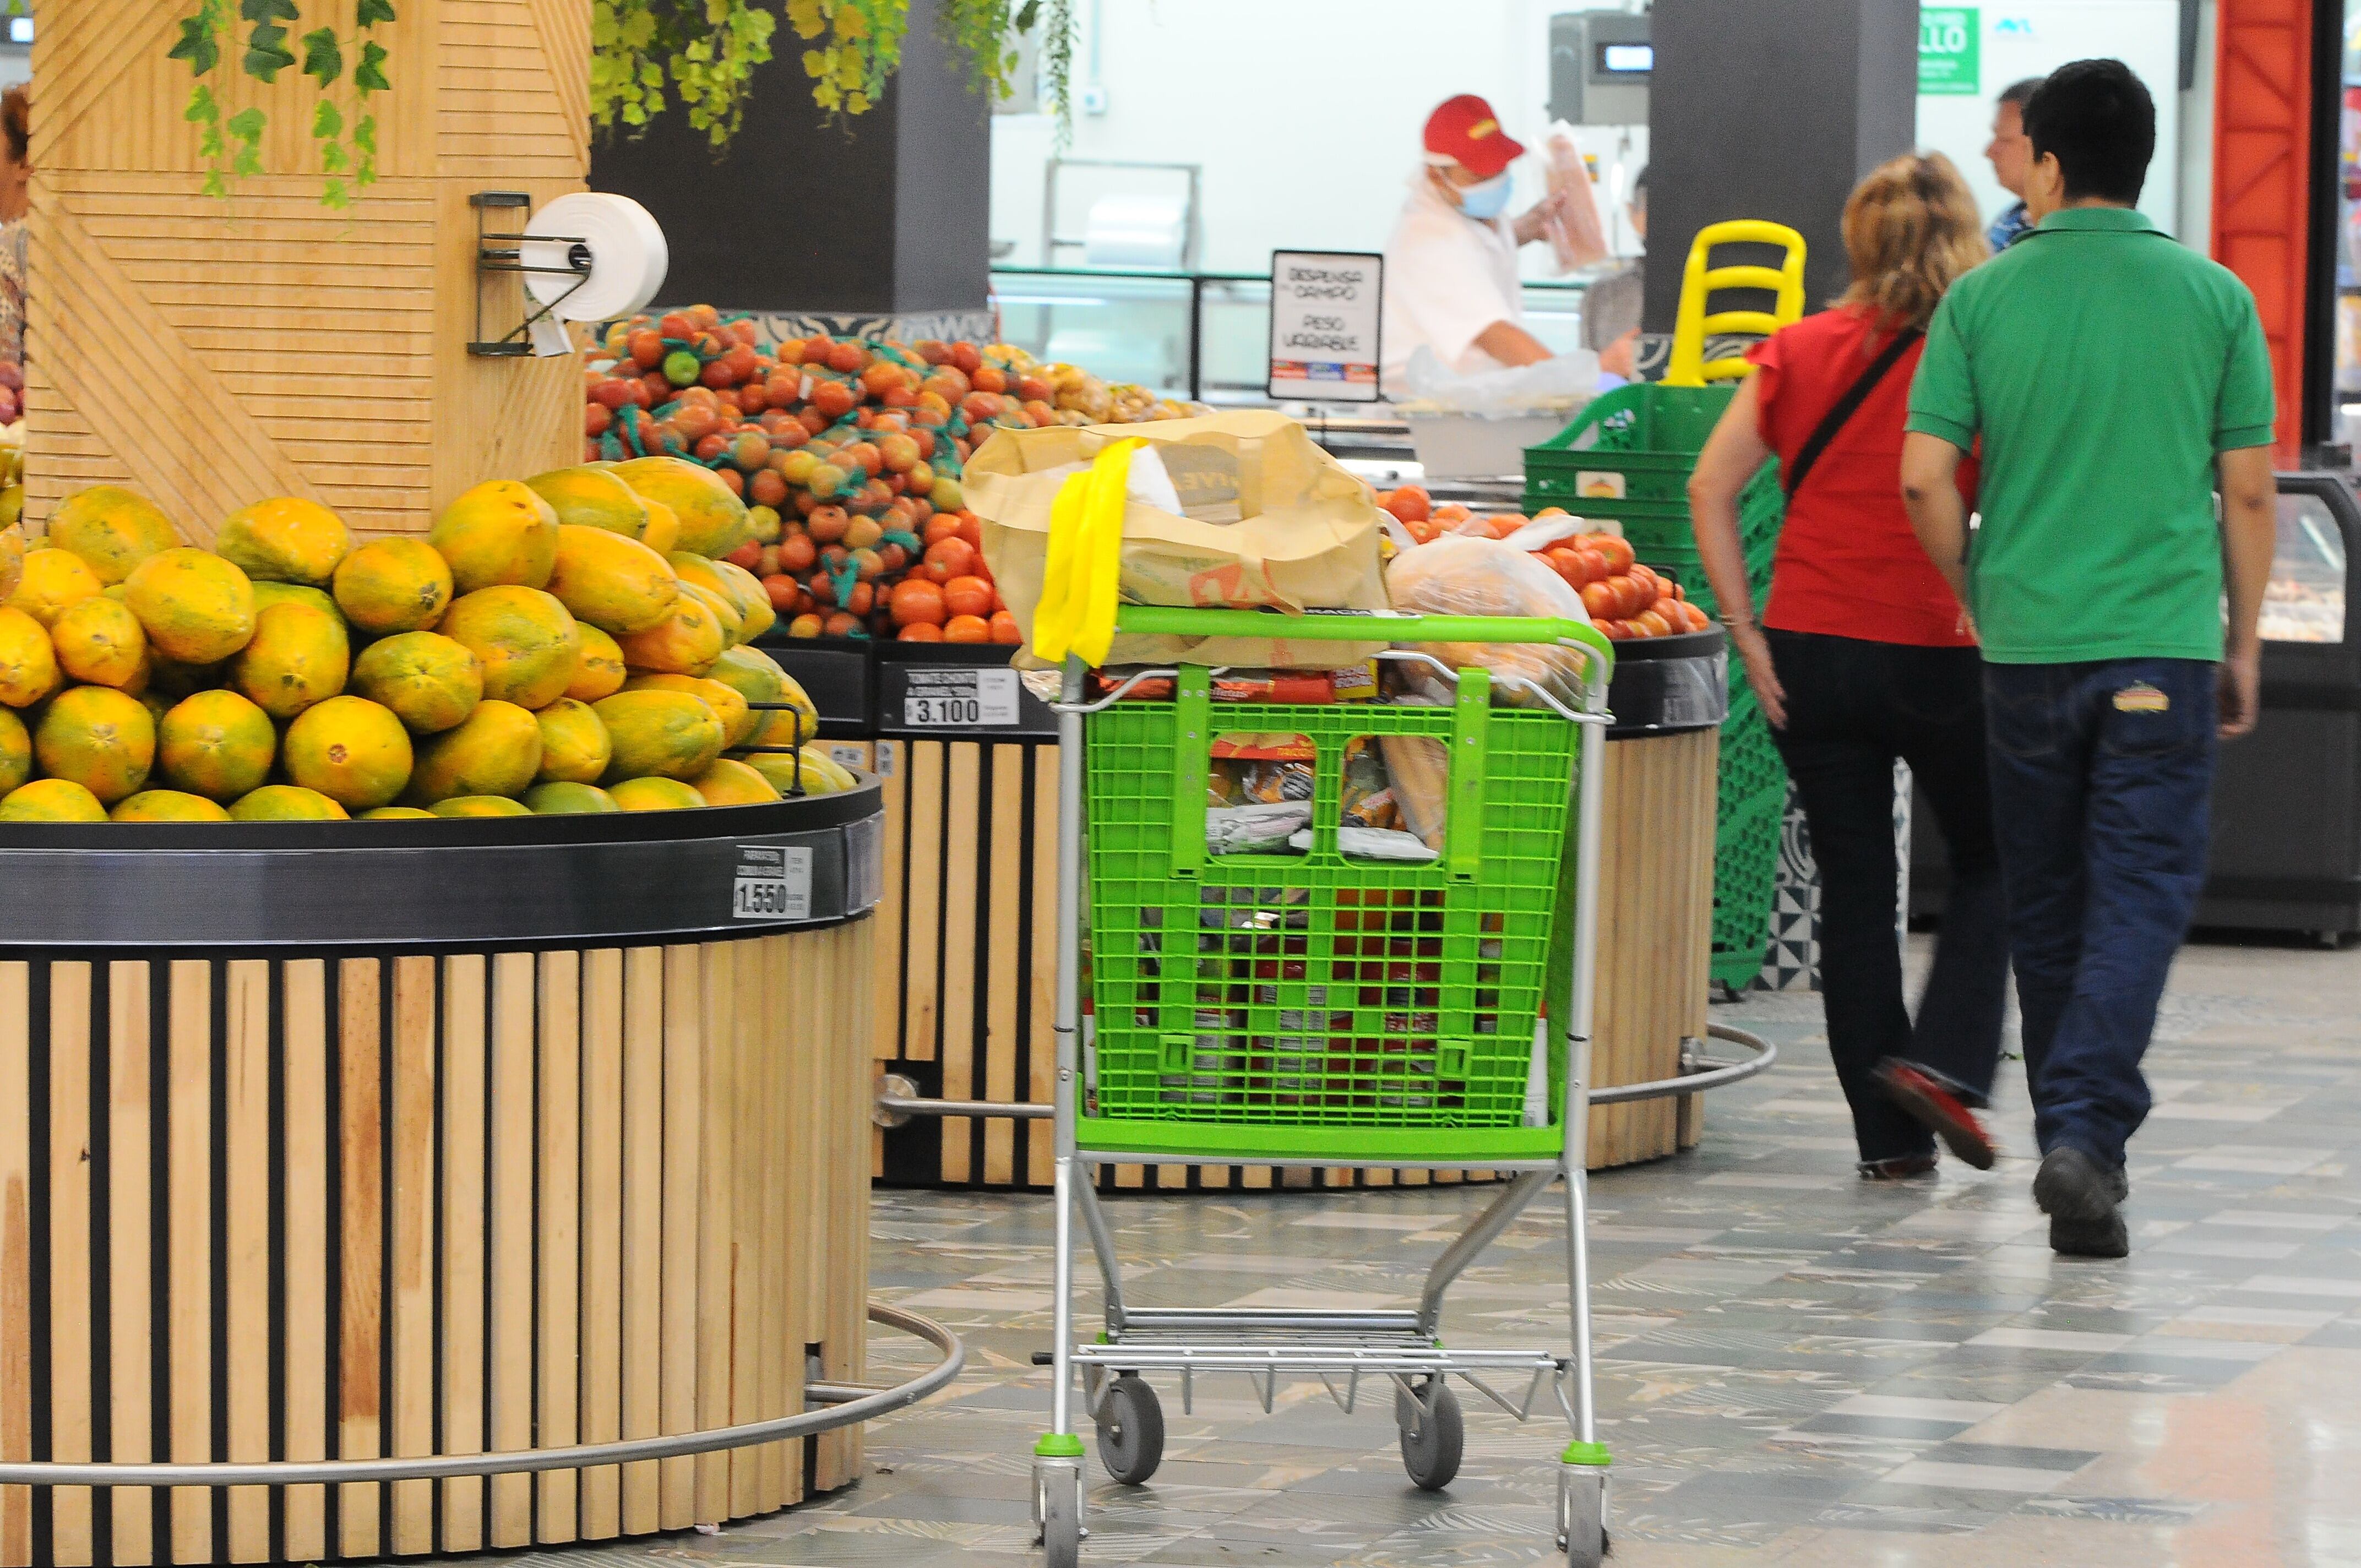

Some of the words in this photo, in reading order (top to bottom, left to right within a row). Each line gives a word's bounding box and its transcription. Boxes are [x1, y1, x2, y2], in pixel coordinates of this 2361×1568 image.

[1303, 314, 1345, 331] PESO
[917, 700, 978, 722] 3.100
[739, 884, 787, 913] 1.550
